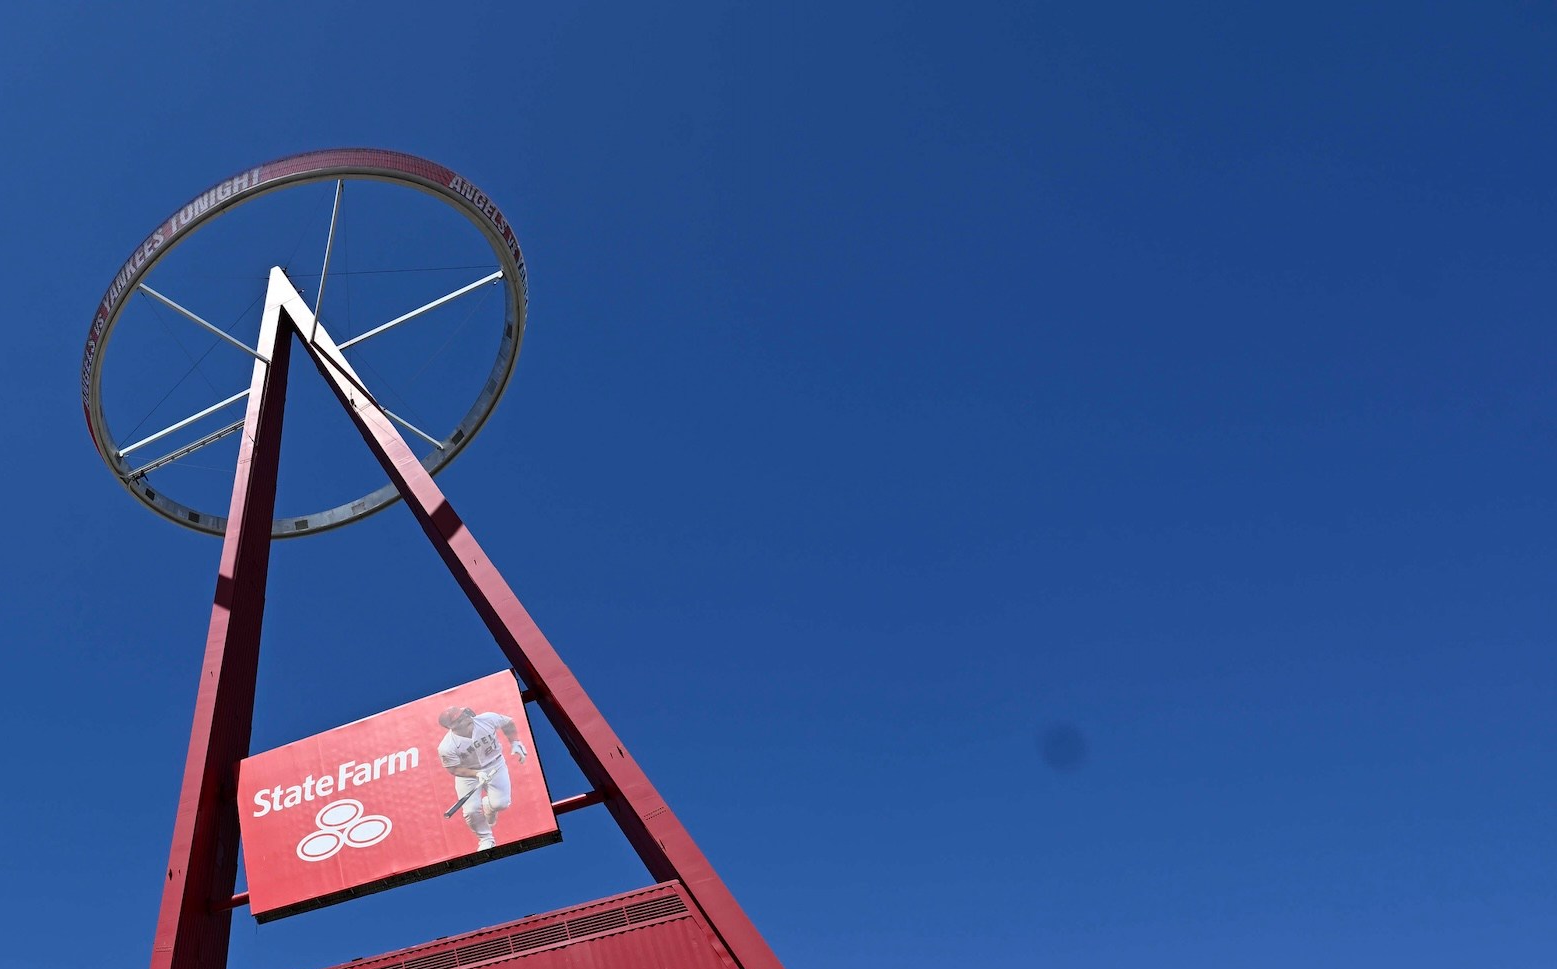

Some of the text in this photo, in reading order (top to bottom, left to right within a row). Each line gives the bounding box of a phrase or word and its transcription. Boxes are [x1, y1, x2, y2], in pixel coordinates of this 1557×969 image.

[103, 228, 164, 313] YANKEES
[171, 168, 260, 233] TONIGHT
[449, 174, 507, 234] ANGELS
